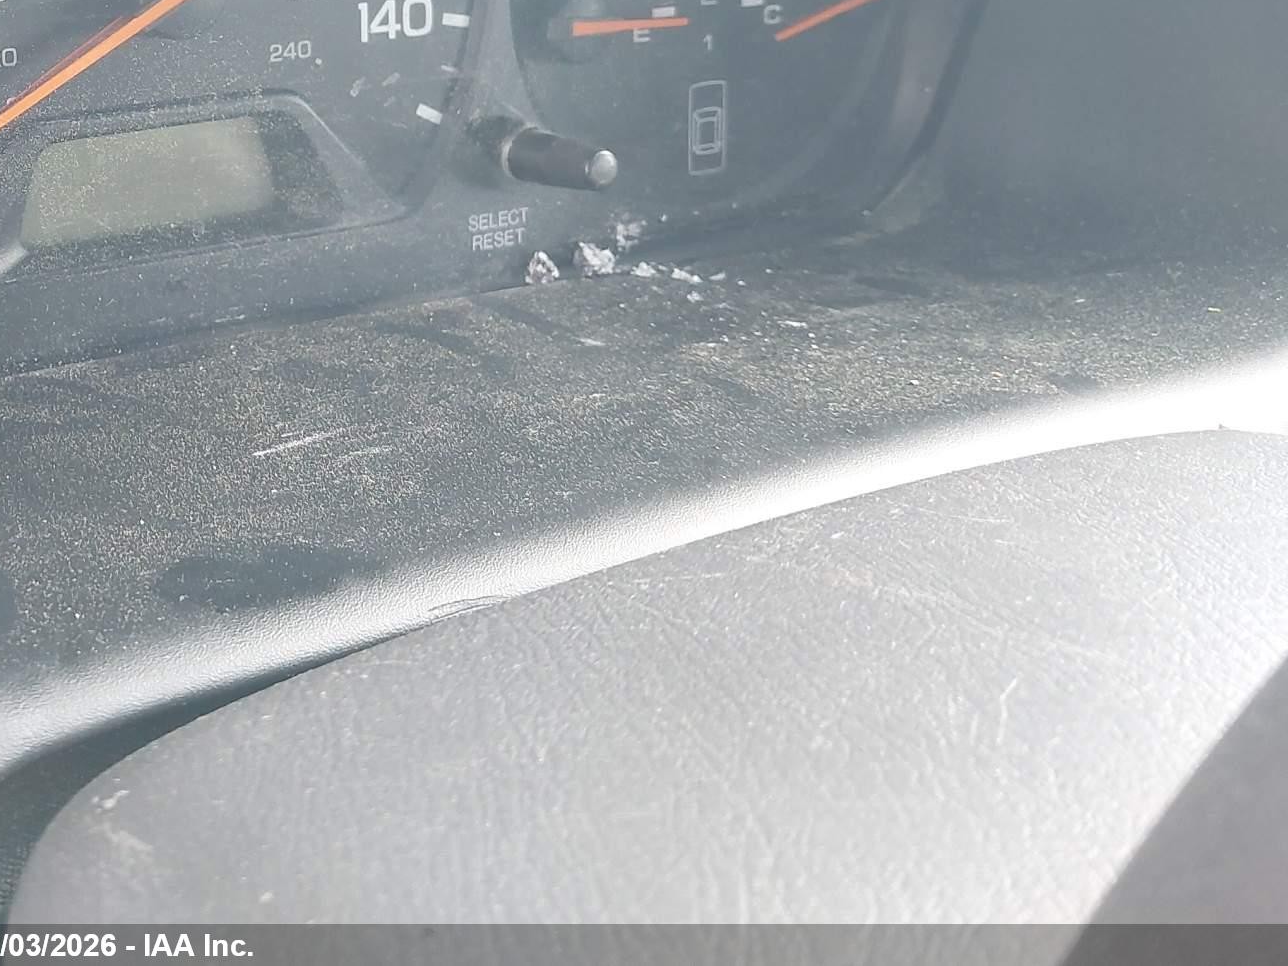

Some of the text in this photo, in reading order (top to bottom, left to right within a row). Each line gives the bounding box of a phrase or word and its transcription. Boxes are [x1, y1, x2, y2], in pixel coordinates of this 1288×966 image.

[762, 5, 784, 25] C
[269, 40, 312, 63] 240
[702, 34, 713, 51] 1
[468, 207, 529, 232] SELECT
[472, 227, 526, 251] RESET
